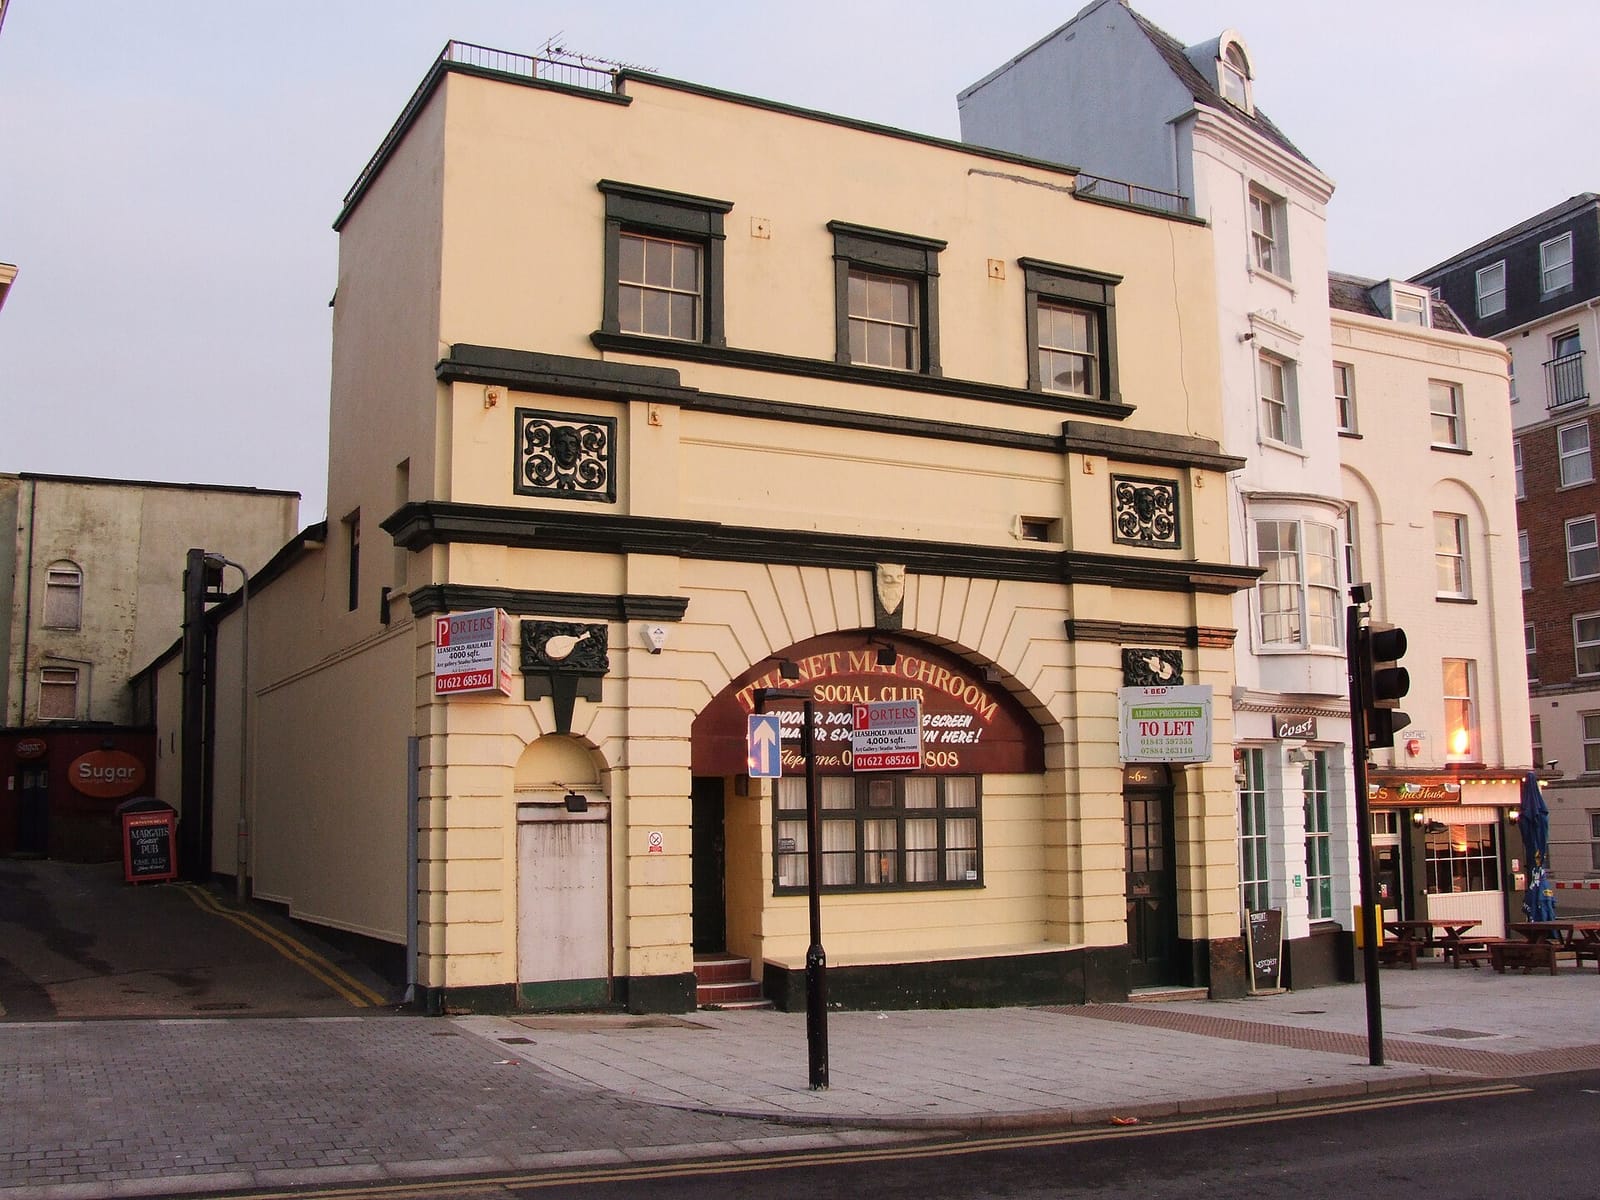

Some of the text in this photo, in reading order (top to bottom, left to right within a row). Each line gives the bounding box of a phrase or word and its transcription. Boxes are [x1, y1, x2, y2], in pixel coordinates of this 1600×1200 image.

[438, 617, 493, 646] PORTERS
[438, 674, 491, 689] 01622 685261
[814, 685, 924, 704] SOCIAL CLUB
[856, 707, 917, 729] PORTERS
[1159, 708, 1200, 717] PROPERTIES
[931, 714, 974, 727] SCREEN
[1279, 717, 1313, 737] Coast
[855, 728, 917, 738] LEASEHOLD AVAILABLE
[941, 728, 983, 744] HERE!
[1139, 721, 1195, 737] TO LET
[857, 756, 883, 767] 01622
[885, 755, 915, 766] 685261
[79, 763, 136, 783] Sugar
[1417, 787, 1447, 799] House
[141, 844, 159, 855] PUB
